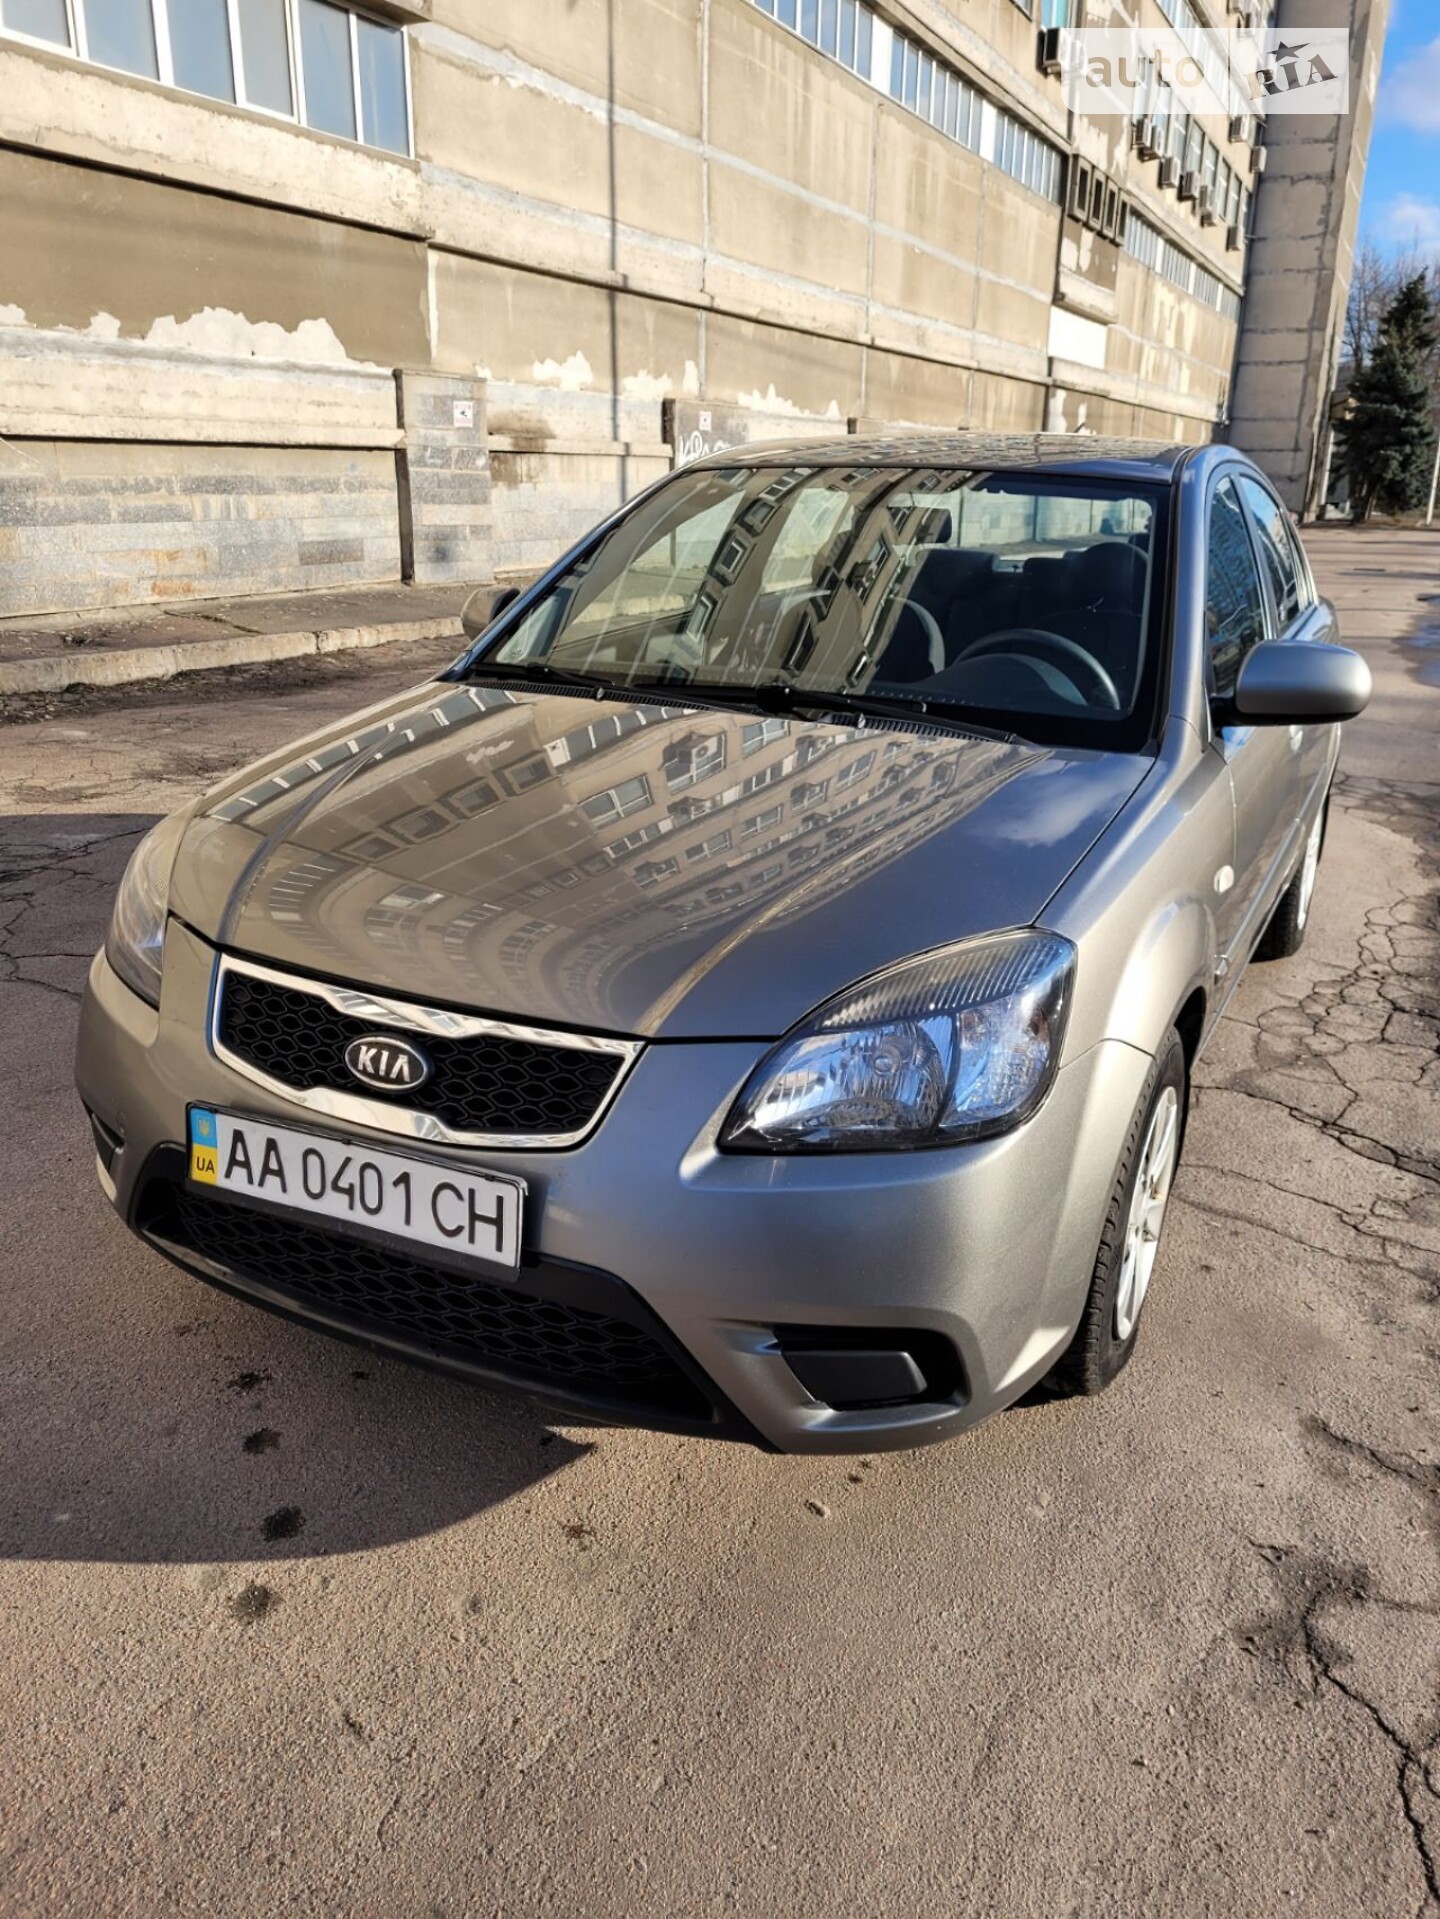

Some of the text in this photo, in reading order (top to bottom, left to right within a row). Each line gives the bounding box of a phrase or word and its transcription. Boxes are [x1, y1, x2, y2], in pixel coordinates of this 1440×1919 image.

[358, 1045, 411, 1083] KIA
[196, 1156, 215, 1174] UA
[224, 1128, 504, 1253] AA 0401 CH
